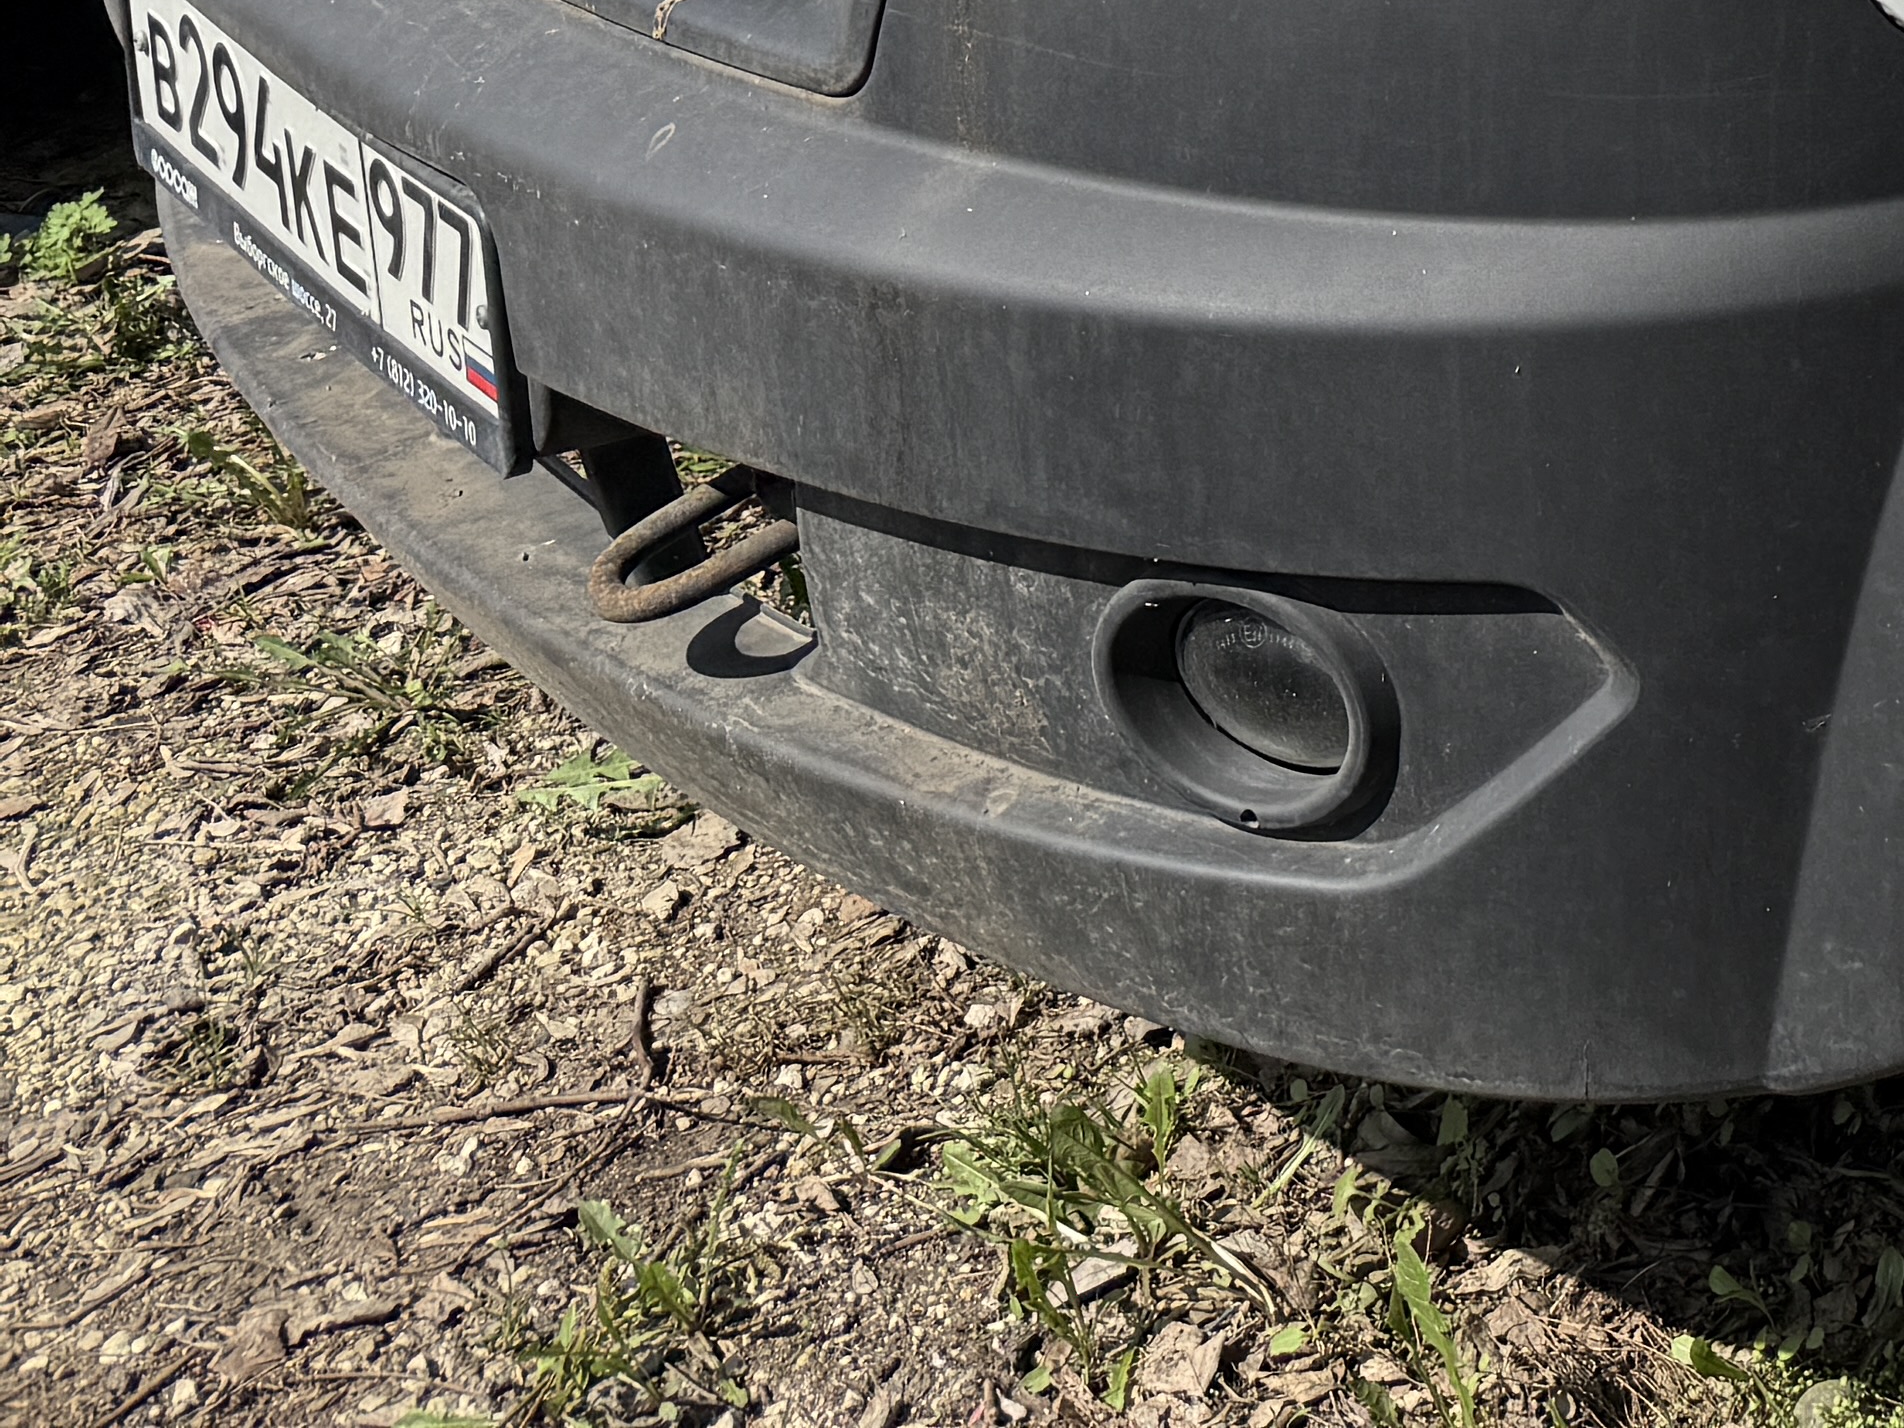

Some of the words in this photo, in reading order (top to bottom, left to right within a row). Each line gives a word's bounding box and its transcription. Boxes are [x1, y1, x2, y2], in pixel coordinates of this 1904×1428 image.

[232, 220, 290, 291] Выборгское
[325, 303, 337, 332] 27
[369, 158, 472, 332] 977
[409, 299, 462, 372] RUS
[370, 346, 385, 372] +7
[386, 355, 415, 397] (812)
[417, 379, 477, 447] 320-10-10
